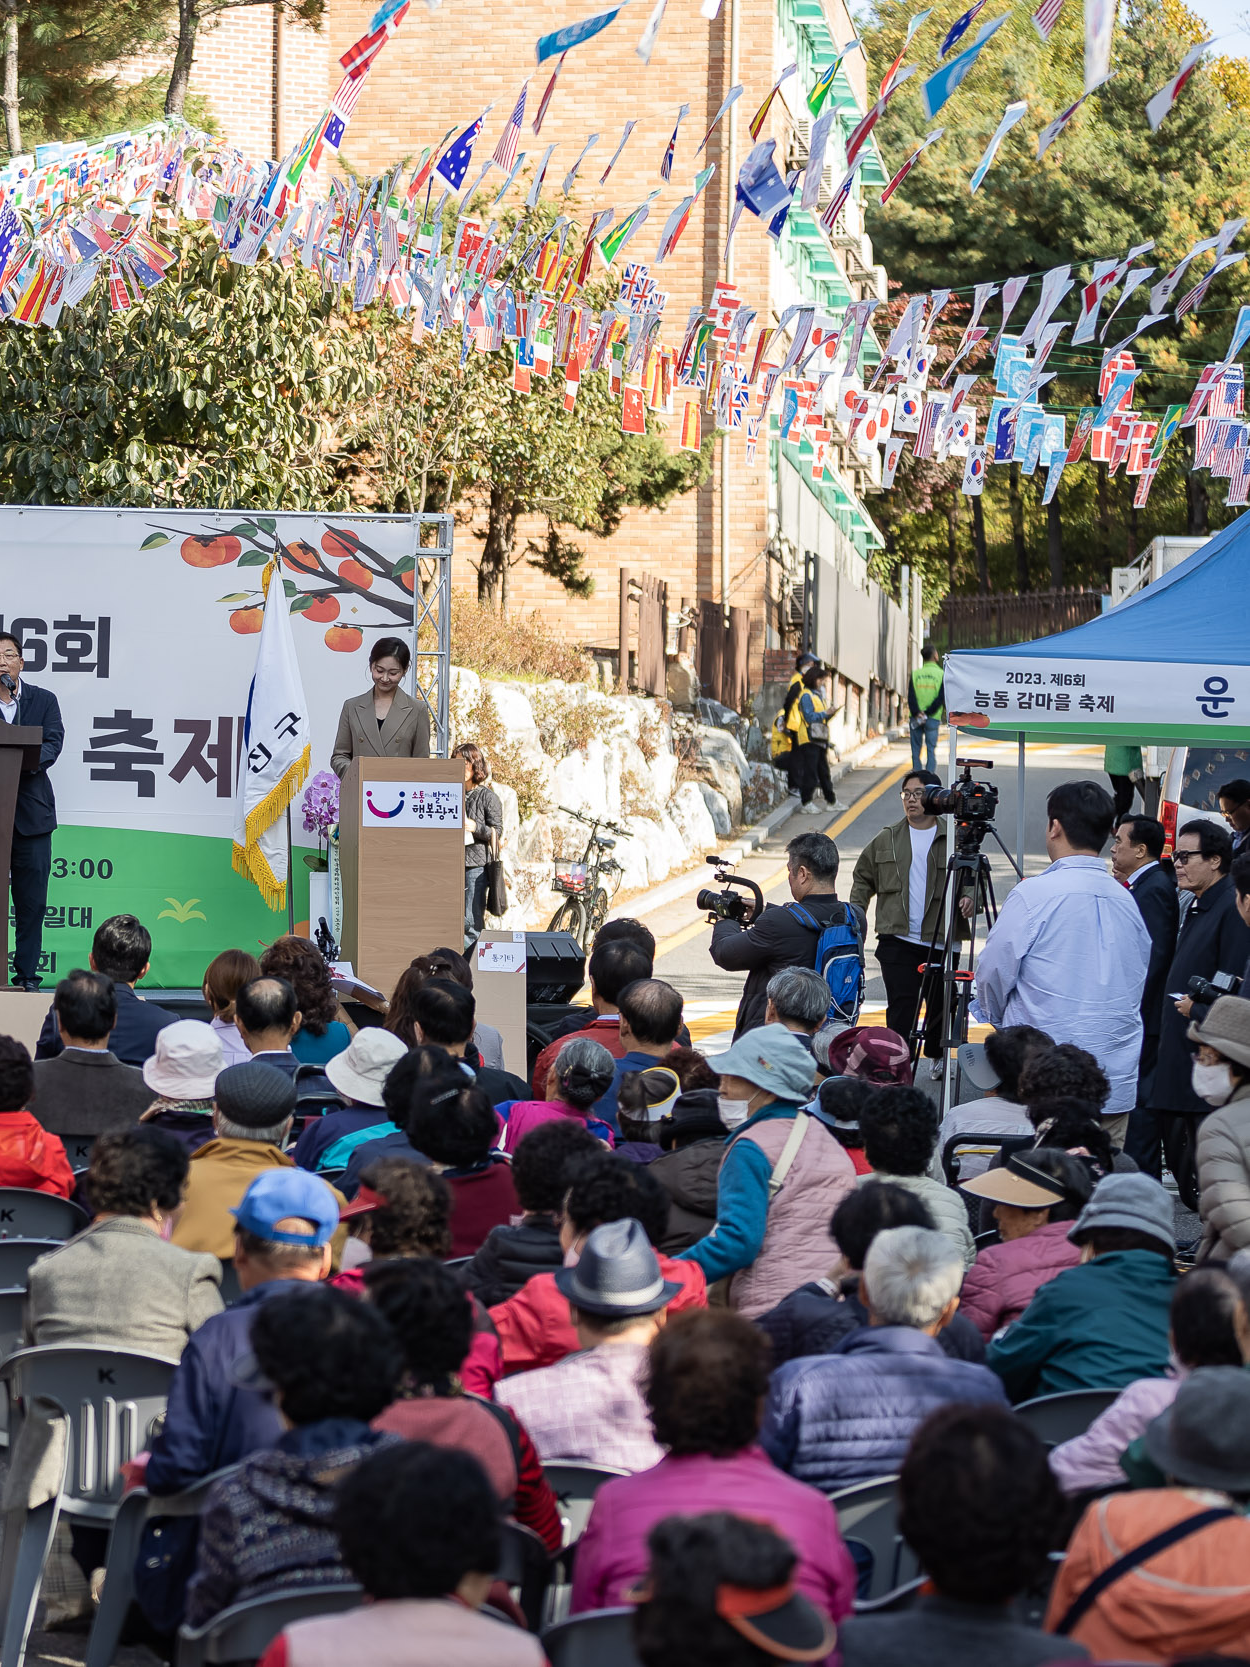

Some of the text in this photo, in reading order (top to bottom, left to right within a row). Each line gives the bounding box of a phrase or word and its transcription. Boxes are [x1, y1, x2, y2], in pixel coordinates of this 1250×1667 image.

[1005, 671, 1087, 688] 2023. 제6회
[973, 689, 1116, 714] 능동 감마을 축제
[1195, 676, 1236, 718] 운
[82, 709, 247, 799] 축제
[411, 803, 459, 821] 행복광진
[44, 905, 93, 929] 일대
[491, 954, 515, 964] 통기타
[76, 1146, 88, 1157] K
[0, 1208, 16, 1222] K
[98, 1367, 116, 1384] K
